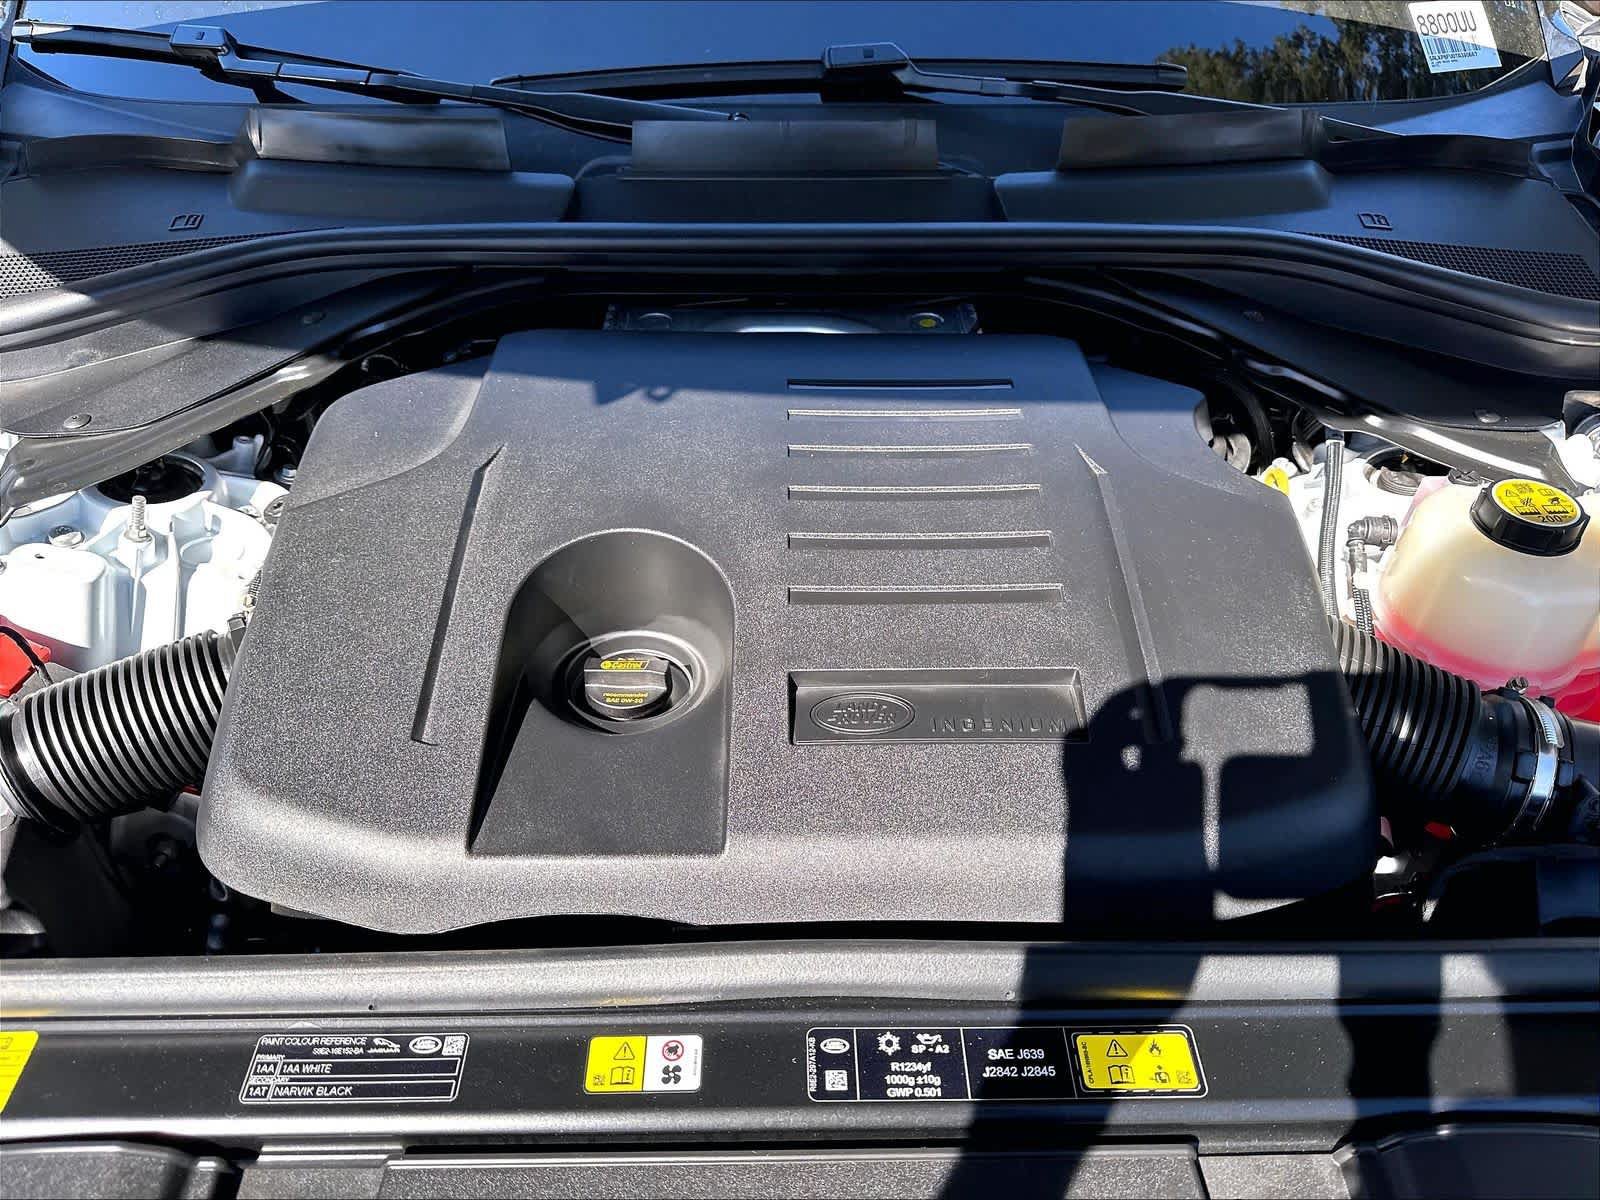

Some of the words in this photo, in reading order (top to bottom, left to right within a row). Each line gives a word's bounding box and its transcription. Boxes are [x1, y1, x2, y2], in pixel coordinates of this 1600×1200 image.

[1416, 9, 1477, 36] 8800UU
[1537, 515, 1563, 523] 200
[931, 717, 1068, 733] INGENIUM
[261, 1037, 285, 1046] PAINT
[285, 1037, 320, 1046] COLOUR
[320, 1036, 368, 1046] REFERENCE
[910, 1044, 926, 1054] SP
[935, 1044, 950, 1054] A2
[987, 1049, 1014, 1060] SAE
[1016, 1049, 1045, 1060] J639
[256, 1064, 275, 1074] 1AA
[282, 1064, 300, 1074] 1AA
[302, 1063, 333, 1074] WHITE
[890, 1062, 932, 1073] R1234yf
[982, 1066, 1018, 1077] J2842
[1021, 1066, 1056, 1077] J2845
[884, 1074, 915, 1086] 1000g
[248, 1086, 269, 1096] 1AT
[273, 1086, 314, 1097] NARVIK
[315, 1086, 353, 1097] BLACK
[886, 1087, 914, 1098] GWP
[914, 1087, 942, 1098] 0.501
